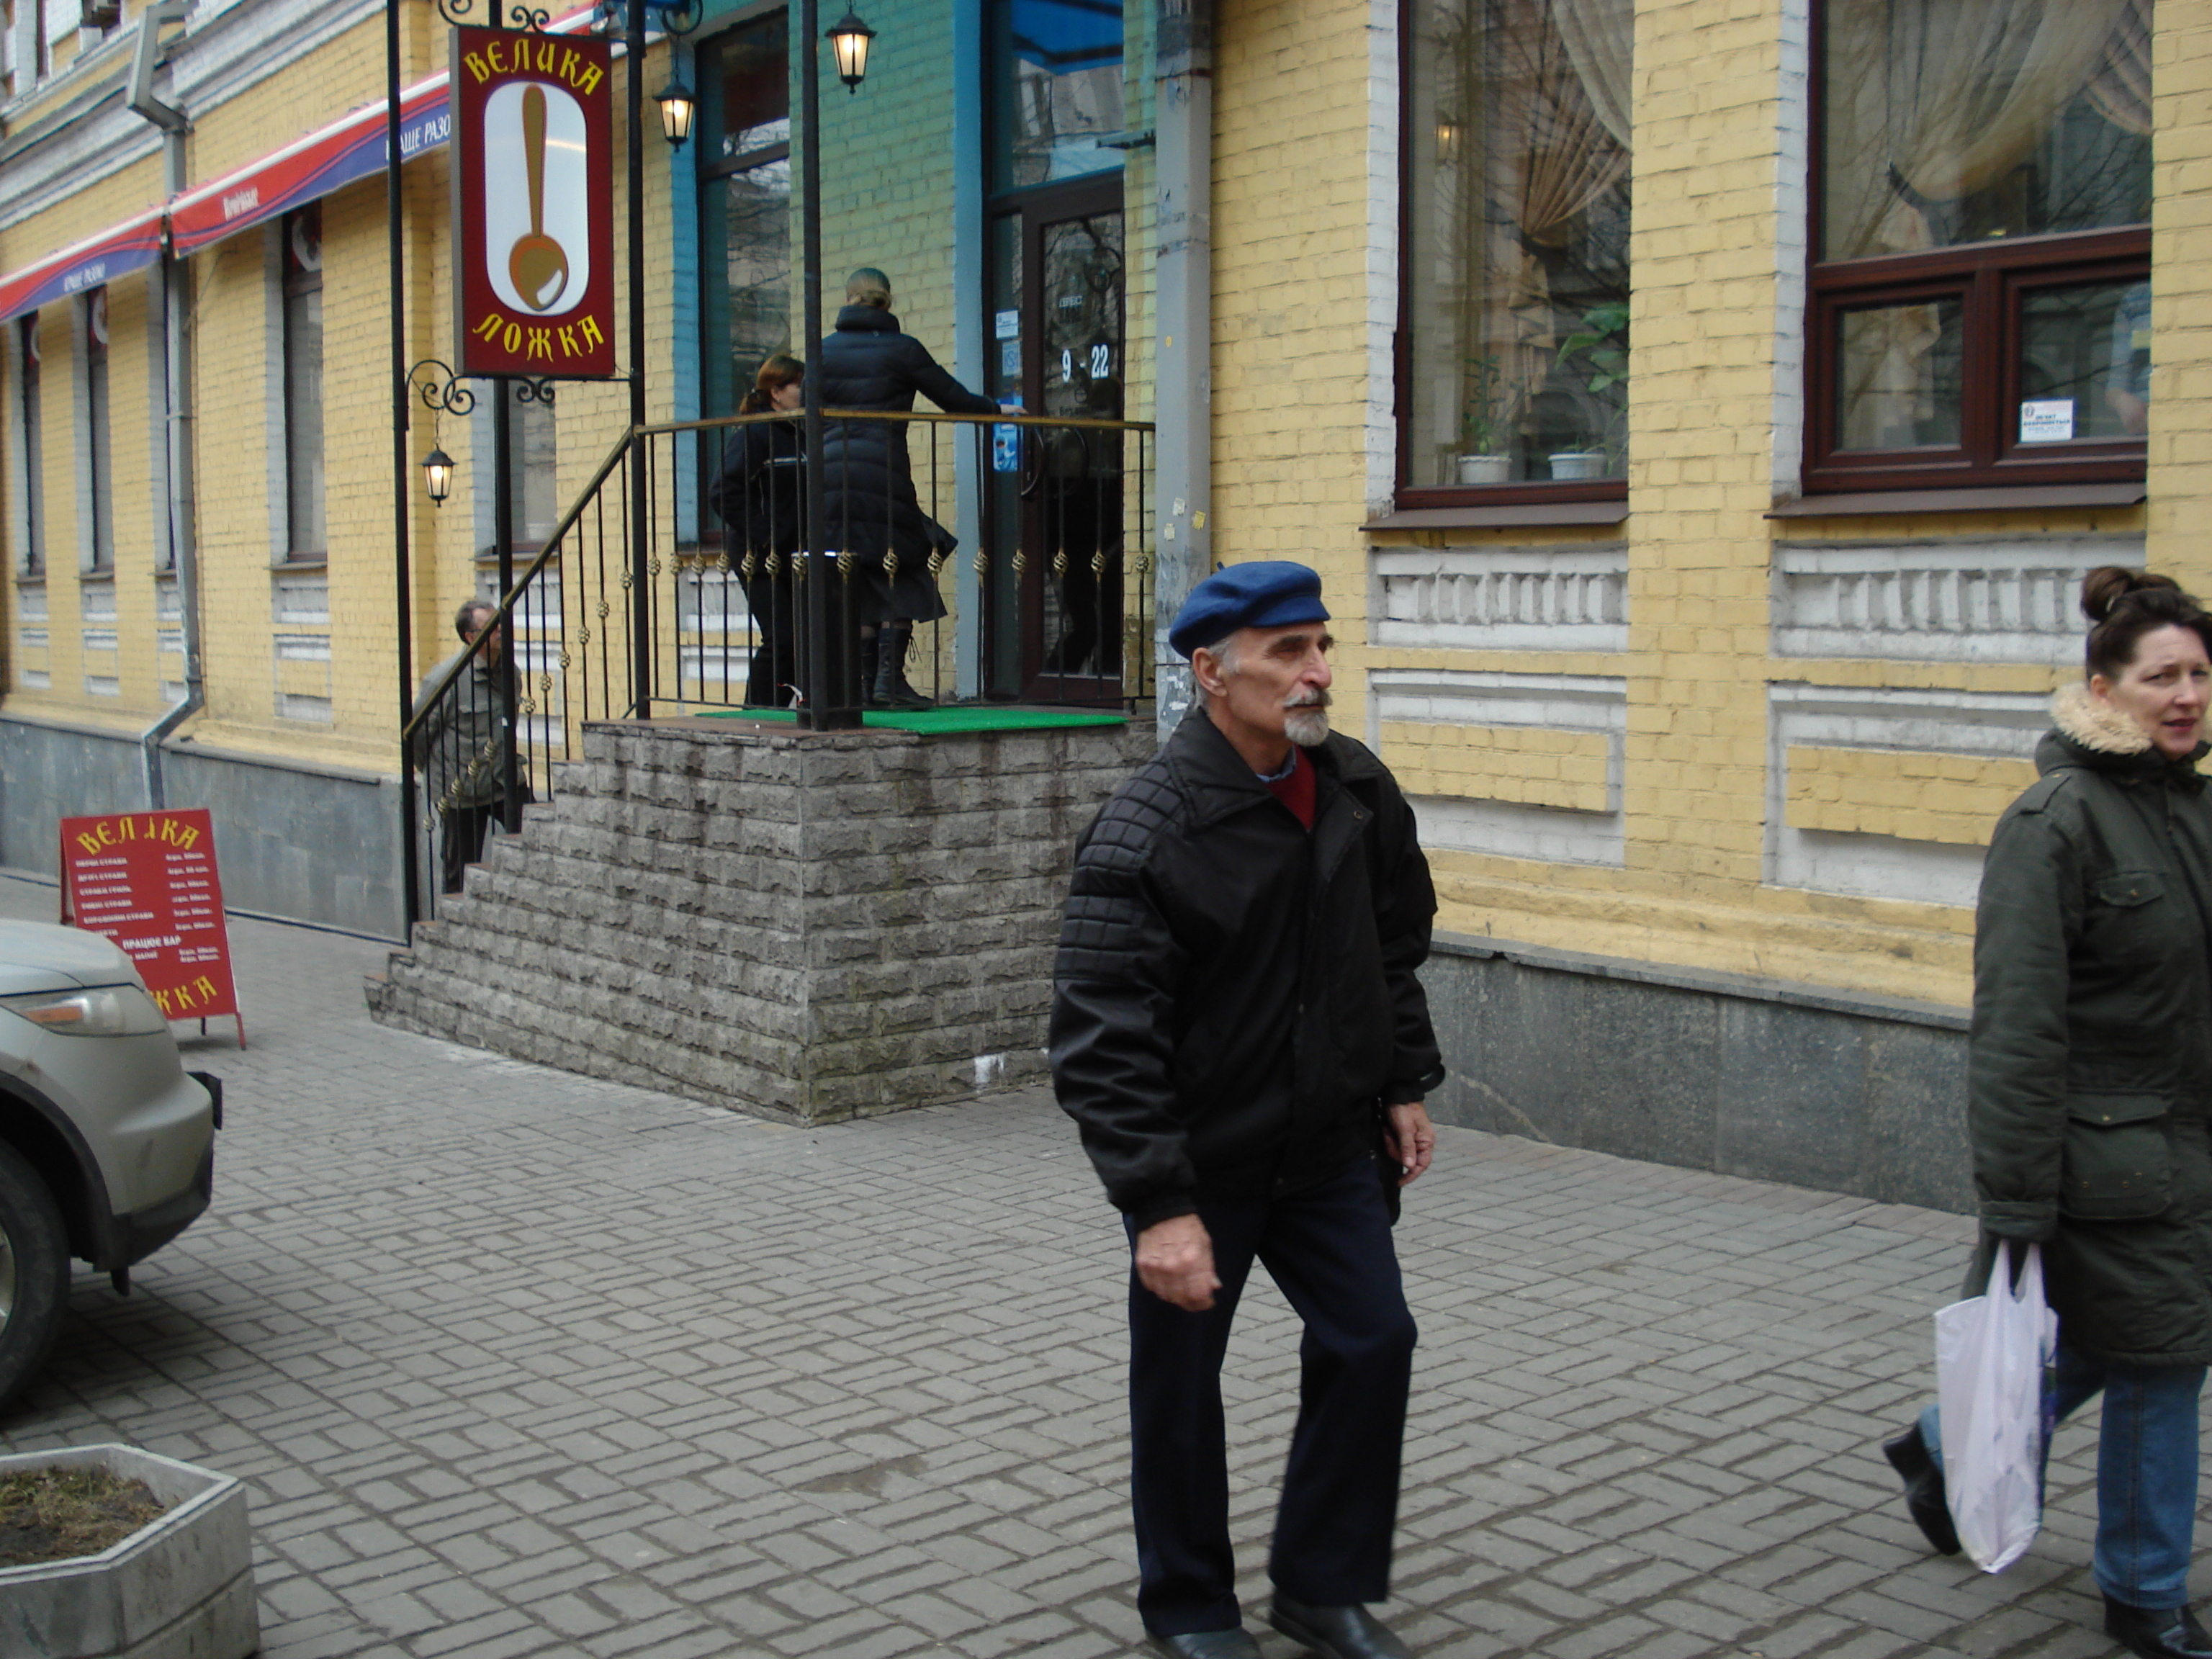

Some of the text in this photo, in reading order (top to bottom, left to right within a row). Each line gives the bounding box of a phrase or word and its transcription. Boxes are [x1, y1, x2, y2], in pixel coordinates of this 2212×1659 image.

[464, 38, 604, 96] ВЕЛИКА
[386, 114, 450, 160] АЩЕ РАЗО
[472, 313, 604, 362] ЛОЖКА
[1062, 349, 1071, 383] 9
[1091, 344, 1109, 379] 22
[163, 935, 181, 947] БАР
[149, 975, 217, 1015] ЖКА
